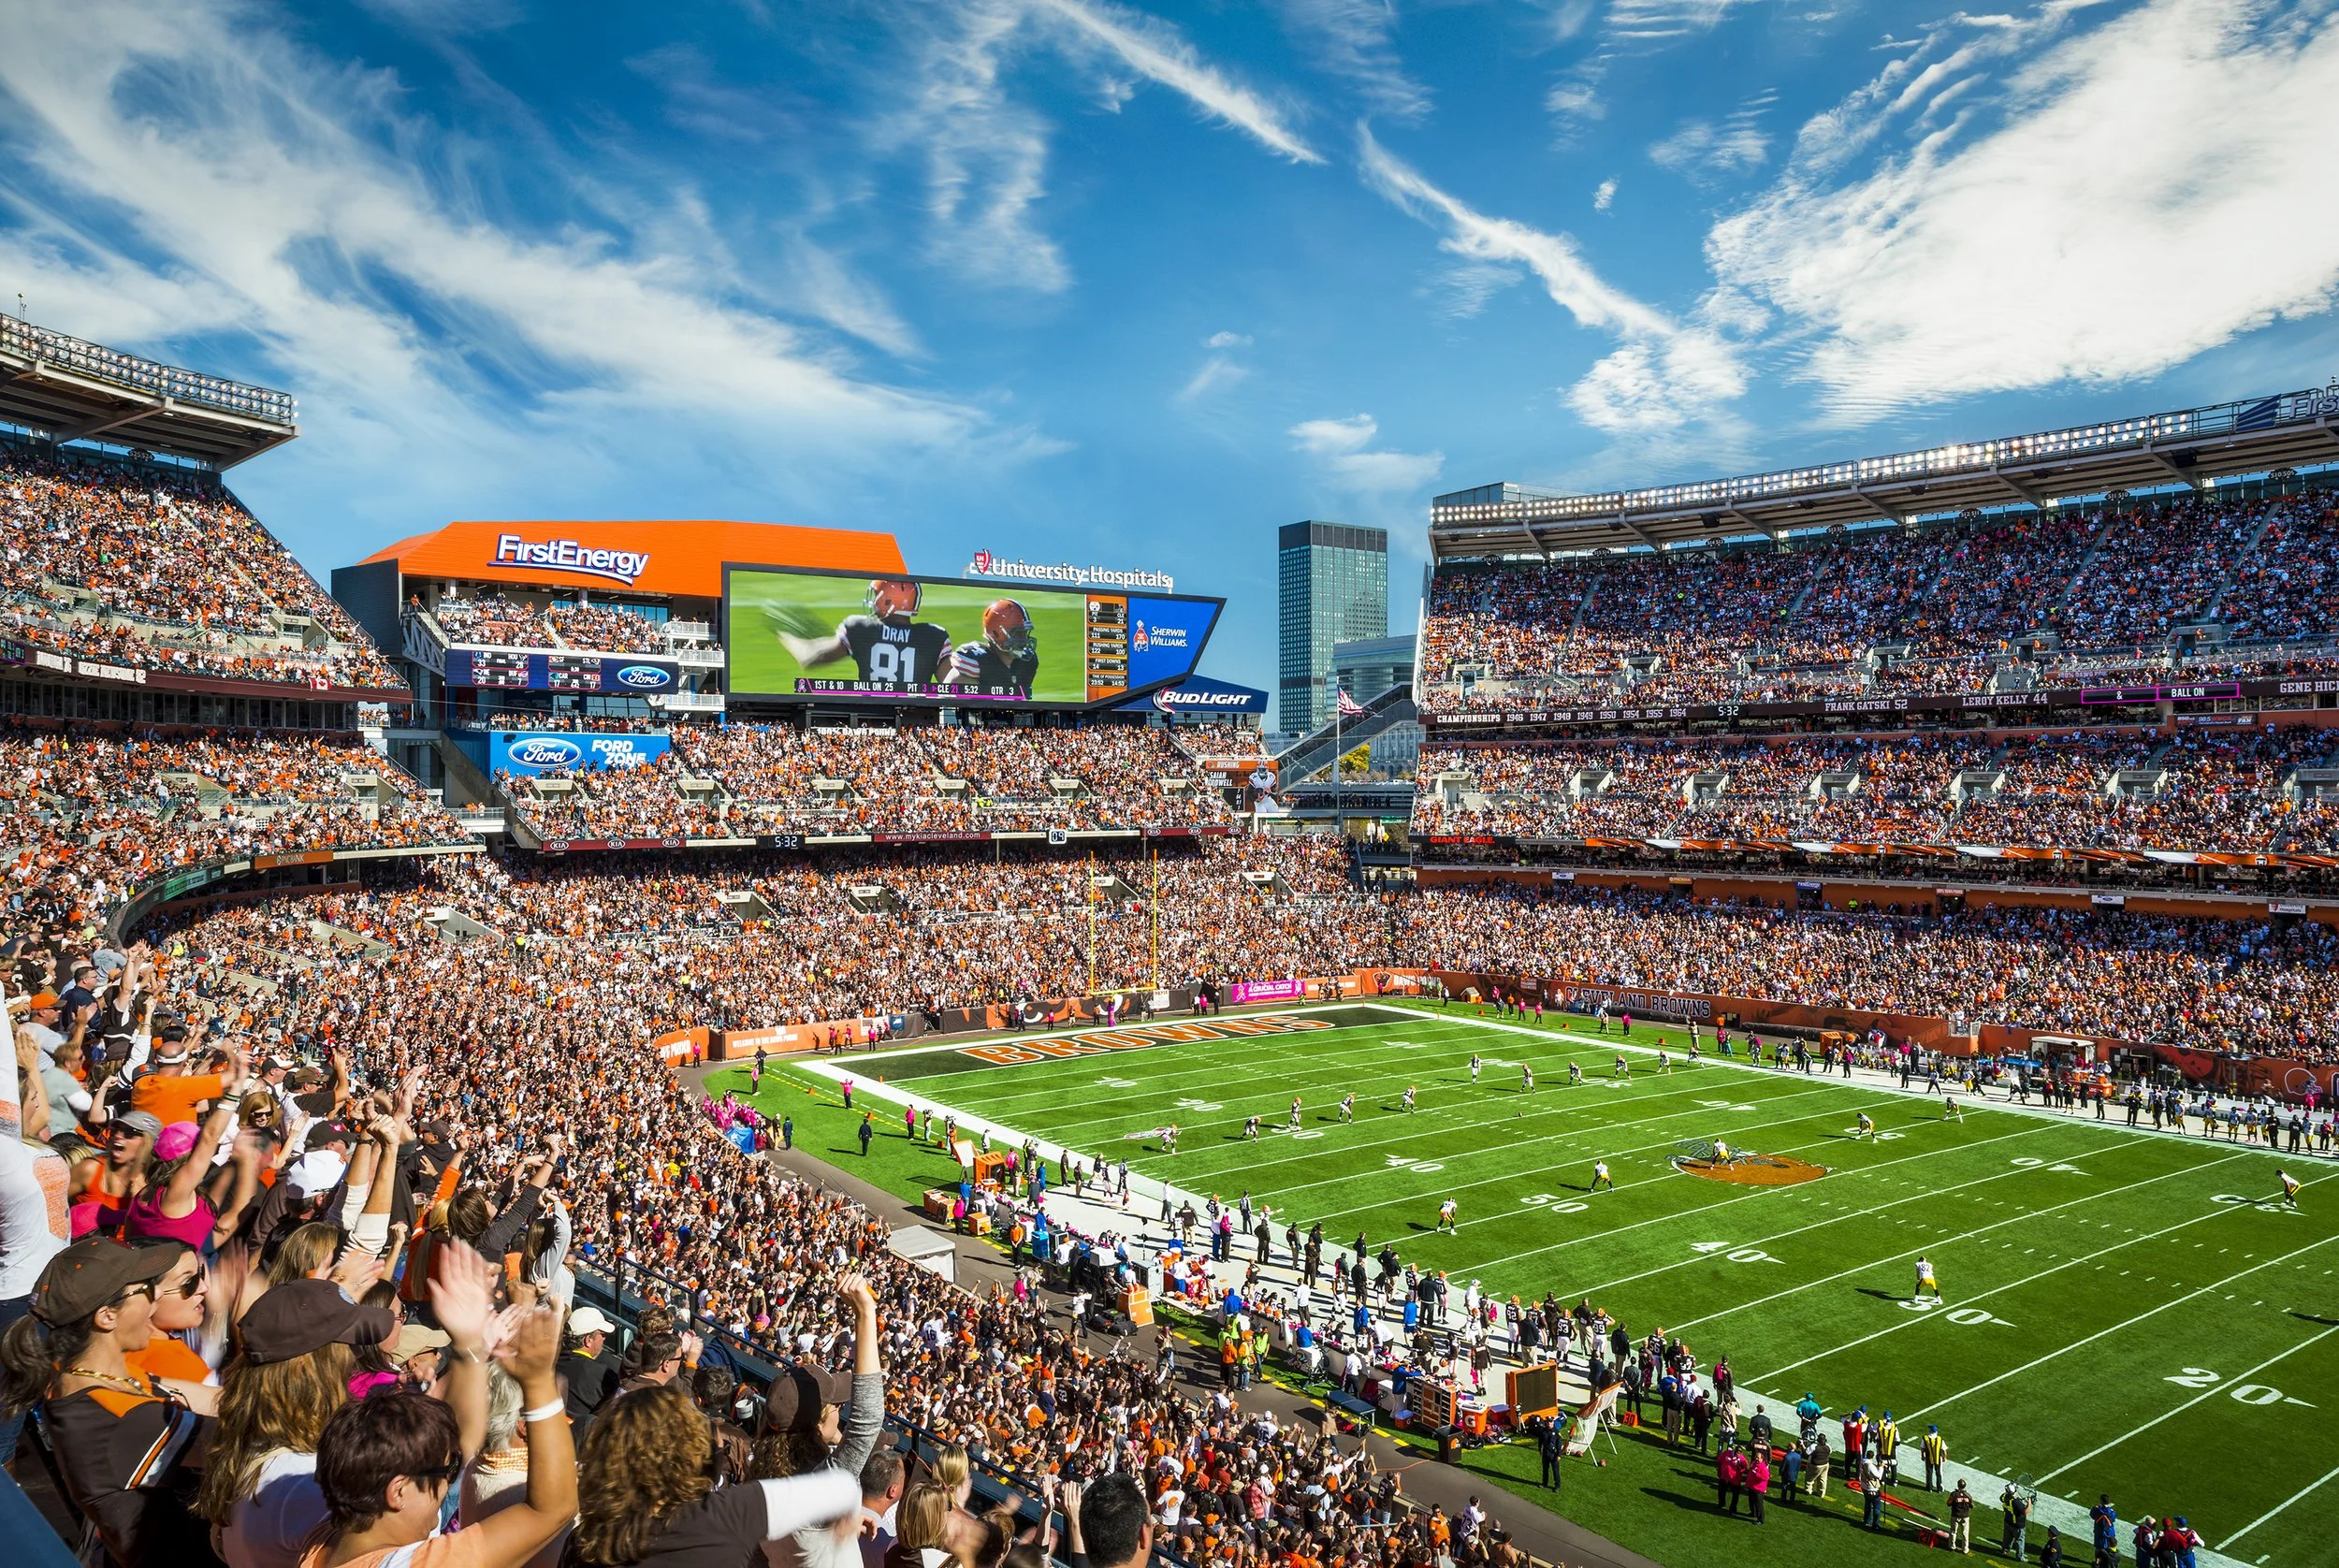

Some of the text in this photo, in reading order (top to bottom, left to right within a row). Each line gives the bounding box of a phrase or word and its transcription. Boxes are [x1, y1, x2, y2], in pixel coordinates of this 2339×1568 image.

[2289, 395, 2339, 418] Firs
[496, 533, 649, 577] FirstEnergy
[992, 558, 1170, 589] University Hospitals
[881, 625, 910, 643] DRAY
[1151, 626, 1186, 636] SHERWIN
[477, 659, 487, 667] 33
[870, 642, 915, 682] 81
[477, 675, 487, 685] 20
[814, 680, 1014, 695] 1ST & 10 BALL ON 25 PIT 3 CLE 21 5:32 QTR 3
[2171, 688, 2204, 698] BALL ON
[2279, 683, 2311, 693] GENE
[1162, 690, 1252, 705] BUD LIGHT
[1963, 692, 2048, 706] LEROY KELLY 44
[2116, 690, 2123, 700] &
[1718, 705, 1739, 717] 5:32
[1824, 699, 1908, 711] FRANK GATSKI 52
[1437, 708, 1686, 723] CHAMPIONSHIPS 1946 1947 1948 1949 1950 1954 1955 1964
[524, 741, 567, 762] Ford
[591, 739, 633, 752] FORD
[604, 752, 646, 766] ZONE
[775, 836, 797, 848] 5:32
[885, 833, 981, 841] www.mykiacleveland.com
[1274, 983, 1292, 992] CATCH
[1650, 995, 1711, 1018] BROWNS
[954, 1015, 1336, 1066] BROWNS
[1173, 1098, 1224, 1111] 20
[1384, 1157, 1446, 1174] 40
[1519, 1193, 1589, 1214] 50
[1691, 1241, 1768, 1263] 40
[1921, 1263, 1930, 1272] 82
[1506, 1311, 1517, 1321] 92
[1897, 1295, 1993, 1325] 30
[1557, 1323, 1569, 1334] 93
[926, 1329, 936, 1342] 16
[1649, 1340, 1661, 1353] 56
[2163, 1368, 2284, 1405] 20
[1465, 1415, 1476, 1428] G
